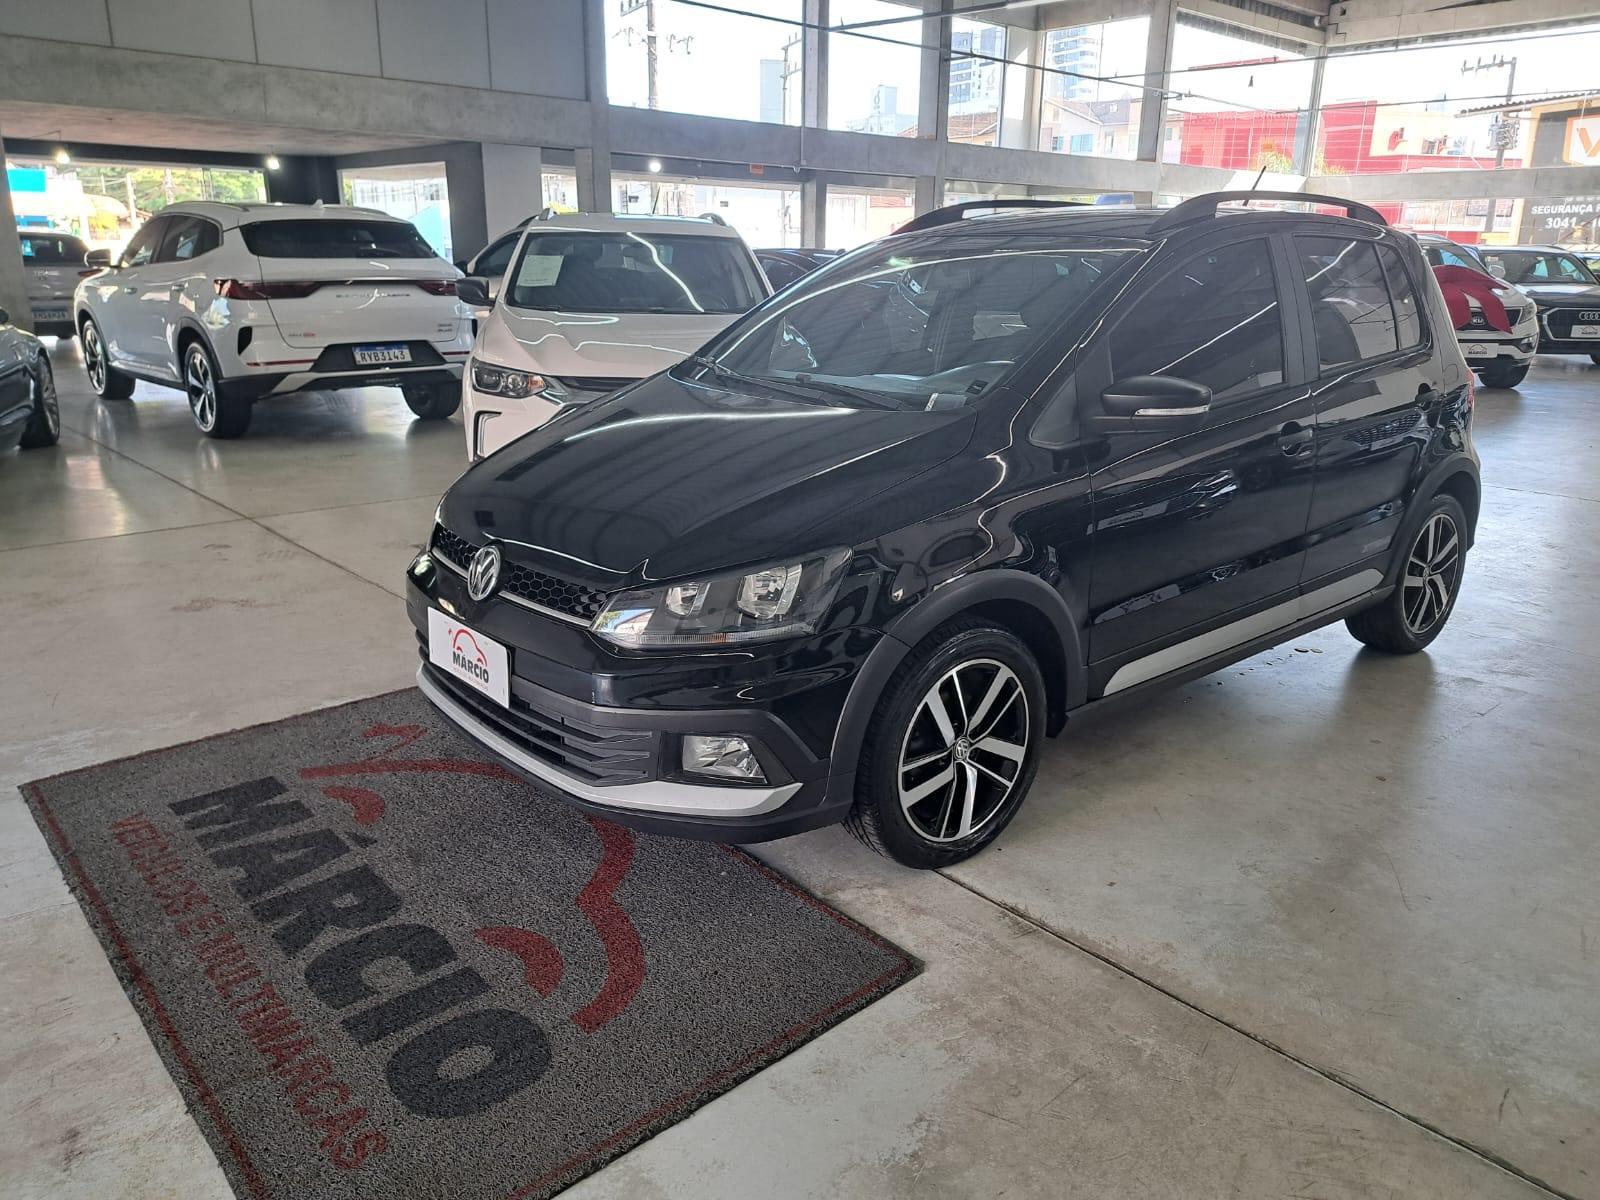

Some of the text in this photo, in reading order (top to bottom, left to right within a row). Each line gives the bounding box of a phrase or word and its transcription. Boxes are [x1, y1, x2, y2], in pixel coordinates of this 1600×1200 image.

[1531, 204, 1593, 216] SEGURANÇA
[1545, 217, 1577, 229] 3041
[360, 351, 406, 363] RYB3143
[452, 650, 489, 683] MÁRCIO
[168, 775, 552, 1119] MÁRCIO
